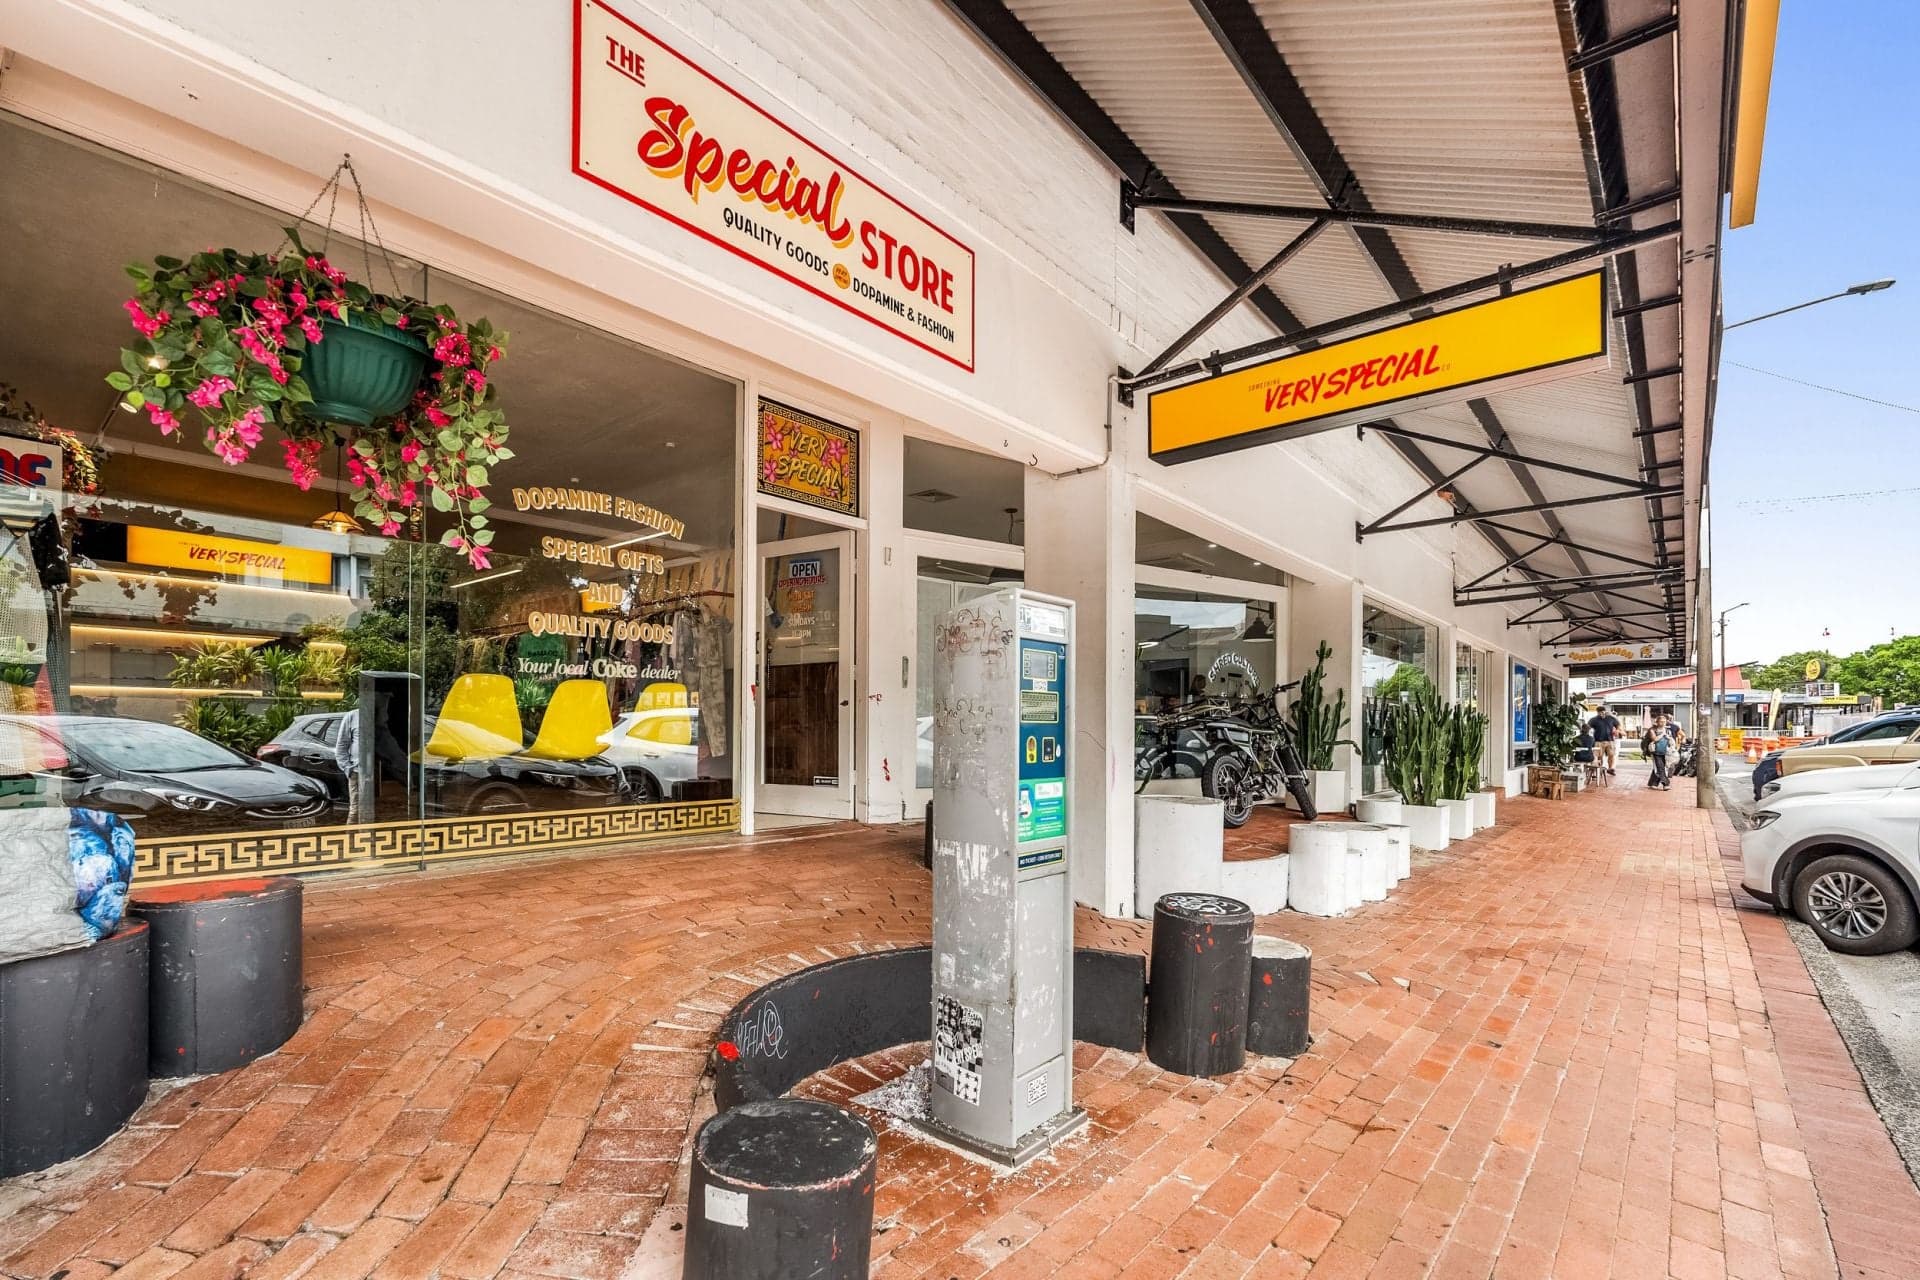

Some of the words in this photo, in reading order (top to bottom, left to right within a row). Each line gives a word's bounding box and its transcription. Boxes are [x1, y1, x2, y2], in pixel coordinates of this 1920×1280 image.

[606, 35, 646, 81] THE
[637, 97, 854, 249] Special
[860, 220, 954, 315] STORE
[723, 207, 783, 251] QUALITY
[786, 241, 829, 277] GOODS
[852, 277, 905, 318] DOPAMINE
[906, 306, 915, 322] &
[917, 311, 955, 344] FASHION
[789, 429, 829, 460] VERY
[774, 454, 841, 491] SPECIAL
[512, 486, 613, 516] DOPAMINE
[614, 496, 685, 541] FASHION
[541, 535, 614, 568] SPECIAL
[617, 549, 665, 575] GIFTS
[791, 562, 818, 577] OPEN
[587, 581, 625, 605] AND
[528, 611, 612, 639] QUALITY
[613, 620, 674, 645] GOODS
[517, 657, 552, 674] Your
[553, 658, 588, 676] local
[592, 658, 637, 679] Coke
[641, 664, 681, 680] dealer
[1208, 653, 1232, 683] SHRED
